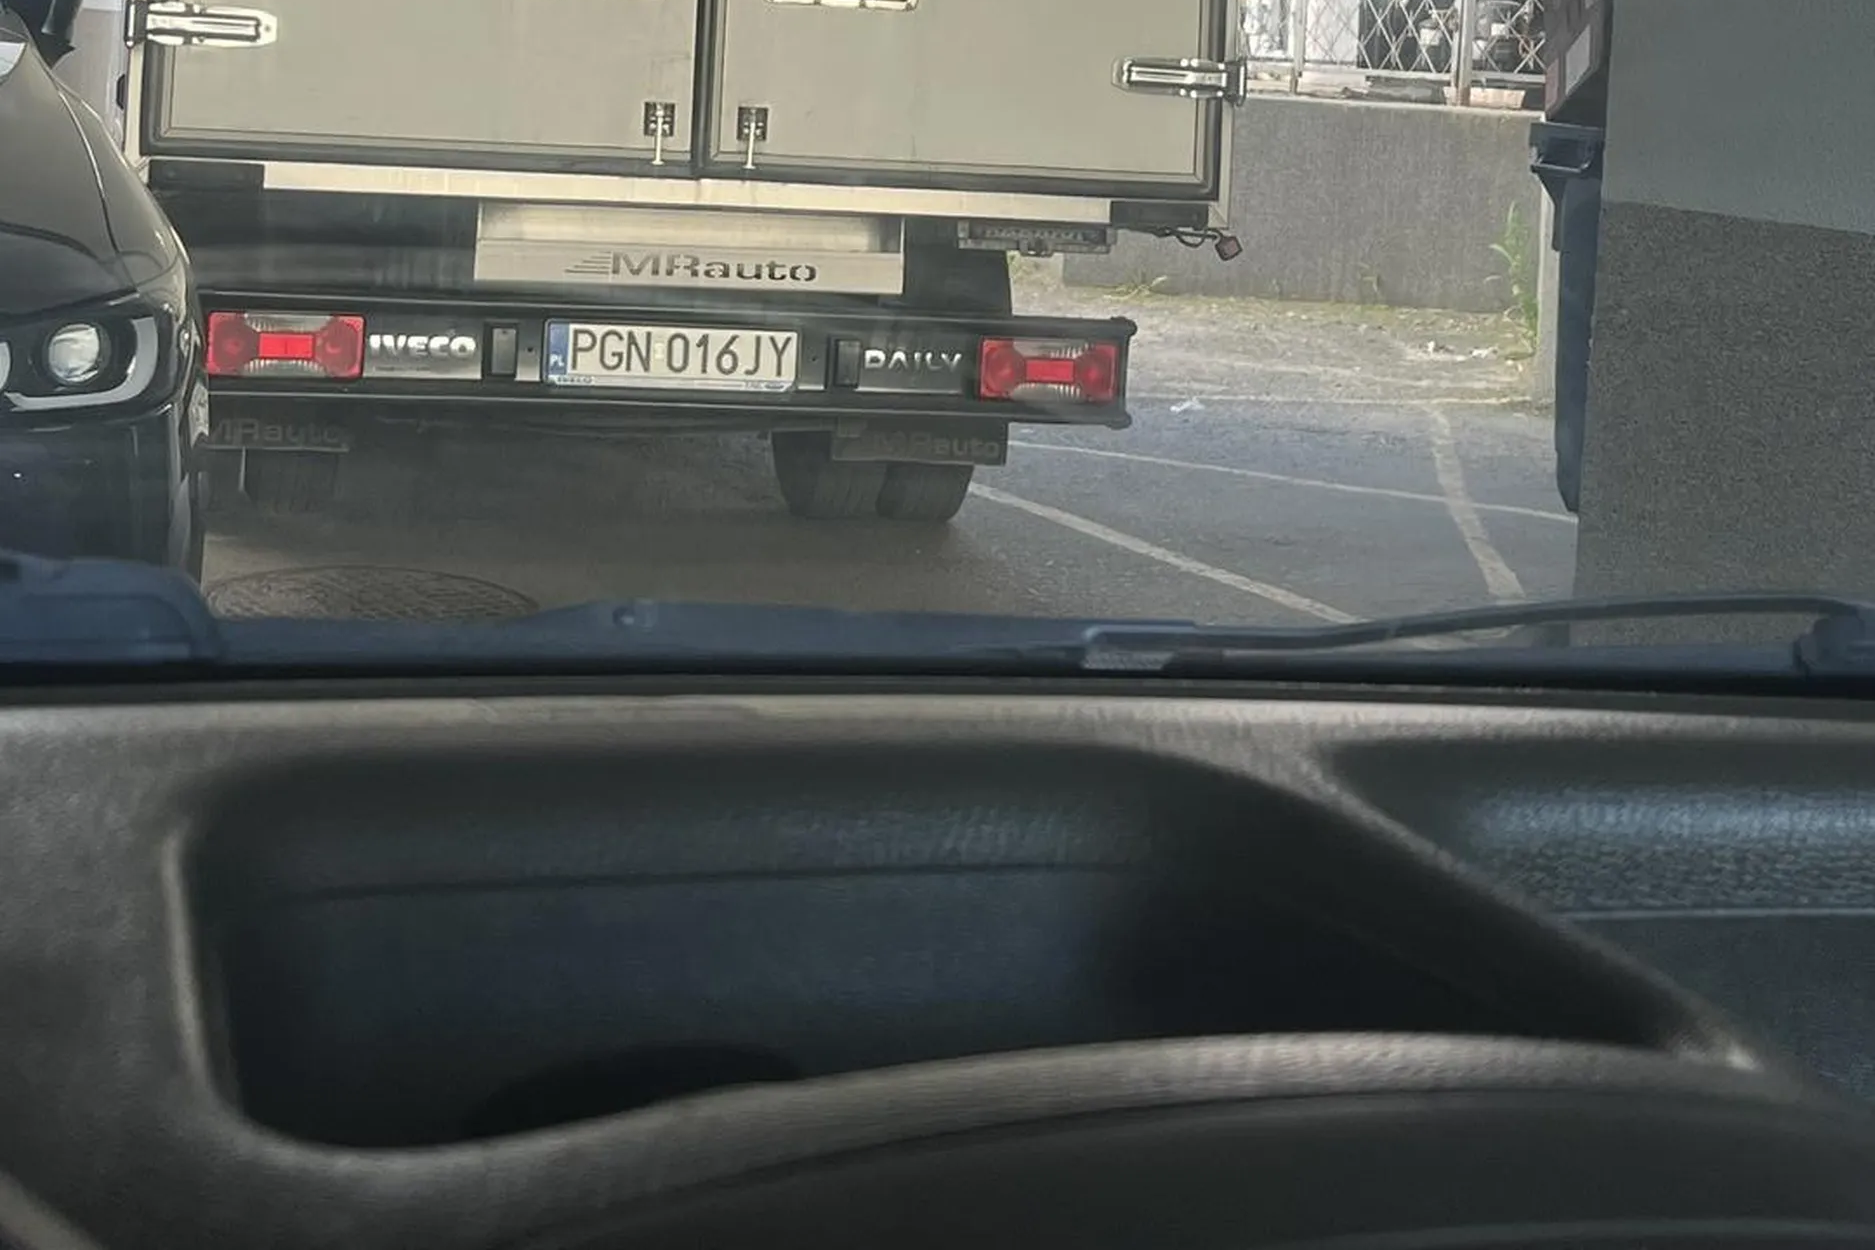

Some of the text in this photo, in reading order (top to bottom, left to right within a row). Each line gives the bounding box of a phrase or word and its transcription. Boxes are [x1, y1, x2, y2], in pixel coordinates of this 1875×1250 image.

[611, 251, 817, 282] MRauto
[368, 333, 477, 358] IVECO
[571, 328, 793, 378] PGN 016JY
[549, 353, 565, 367] PL
[864, 349, 963, 371] DAILY
